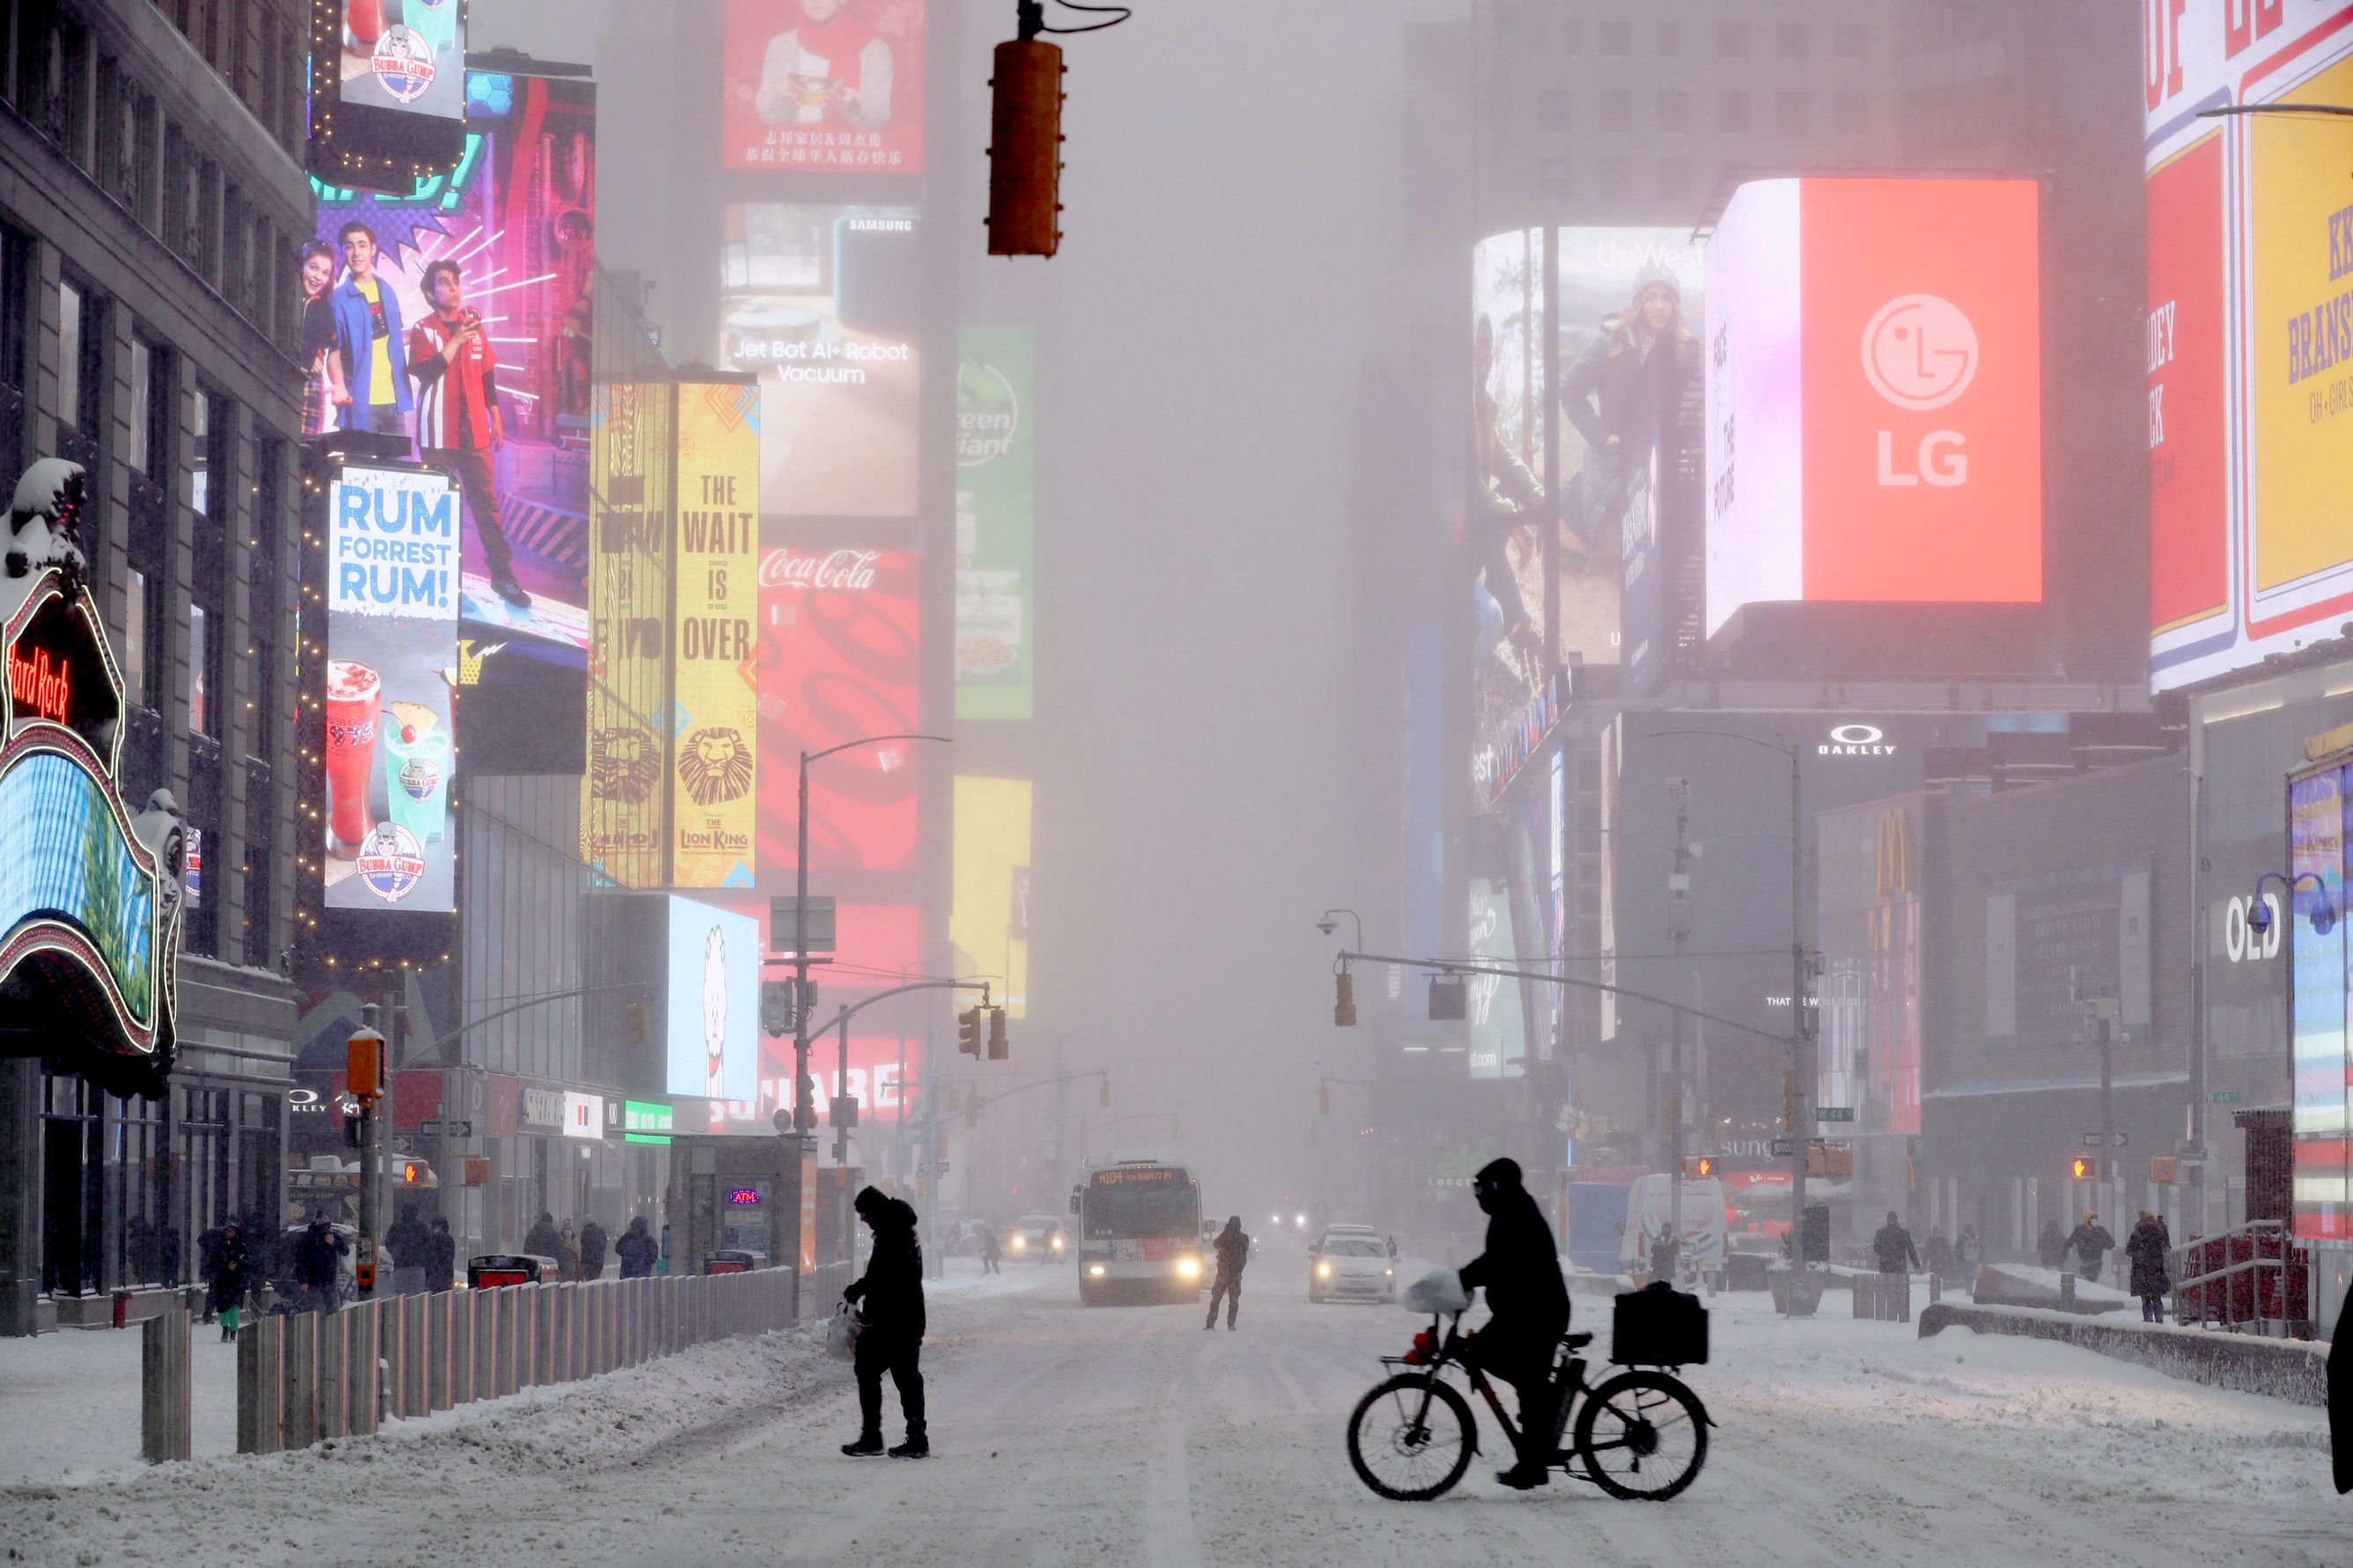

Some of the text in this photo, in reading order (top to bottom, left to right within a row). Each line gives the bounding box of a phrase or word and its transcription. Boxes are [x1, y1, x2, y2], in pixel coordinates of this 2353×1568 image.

[373, 58, 433, 78] BUBBA GUMP
[850, 219, 912, 231] SAMSUNG
[1597, 240, 1704, 274] UpWest
[734, 342, 768, 358] Jet
[771, 342, 807, 358] Bot
[846, 342, 909, 361] Robot
[2288, 289, 2353, 386] BRANS
[777, 364, 865, 384] Vacuum
[957, 432, 1014, 456] iant
[1877, 431, 1967, 487] LG
[700, 475, 736, 505] THE
[339, 484, 451, 536] RUM
[682, 511, 753, 555] WAIT
[339, 536, 451, 566] FORREST
[758, 548, 881, 589] Coca-Cola
[340, 561, 448, 608] RUM!
[708, 569, 727, 600] IS
[683, 616, 750, 661] OVER
[38, 650, 68, 725] Rock
[1818, 746, 1895, 755] OAKLEY
[681, 829, 711, 850] LION
[714, 830, 749, 850] KING
[358, 857, 423, 874] BUBBA GUMP
[2226, 894, 2281, 962] OLD
[1767, 997, 1791, 1005] THAT
[1099, 1171, 1123, 1184] M104
[735, 1191, 756, 1202] ATM
